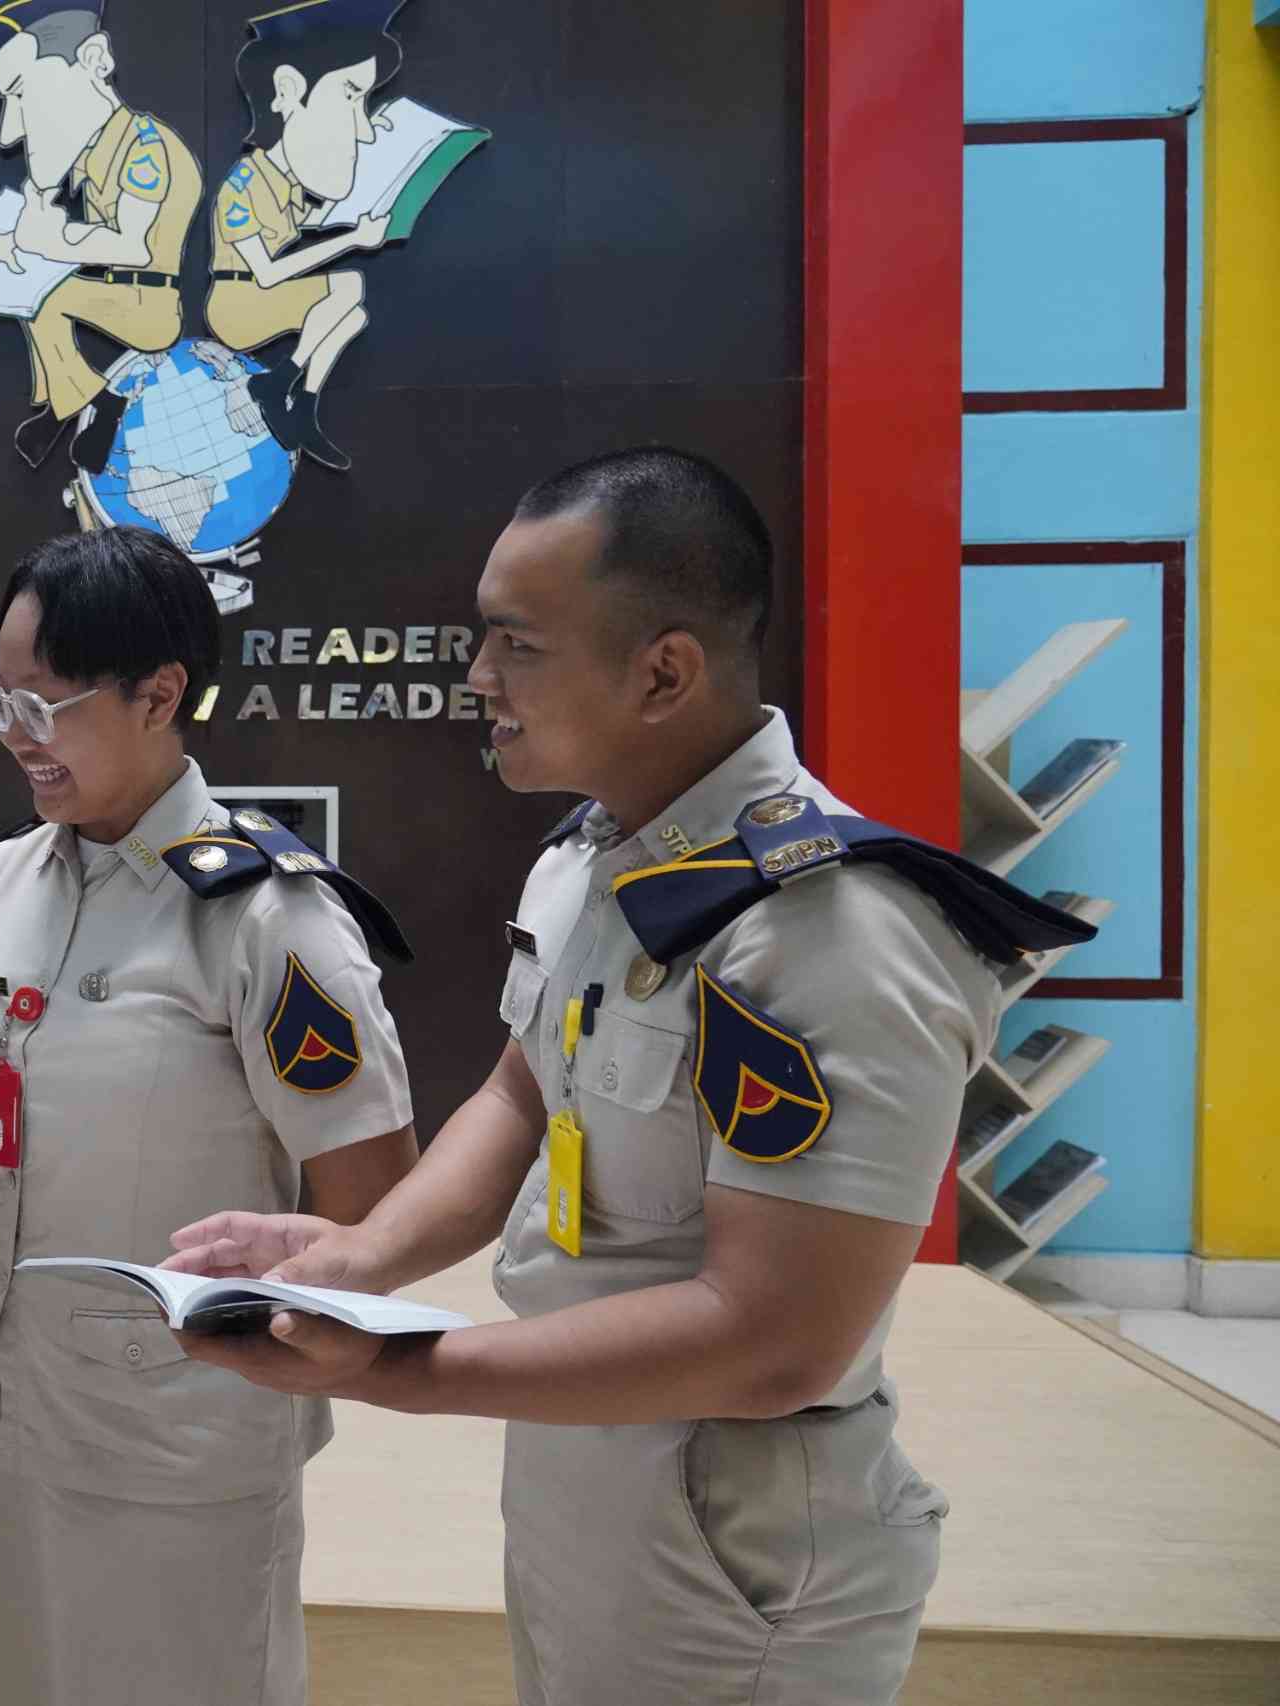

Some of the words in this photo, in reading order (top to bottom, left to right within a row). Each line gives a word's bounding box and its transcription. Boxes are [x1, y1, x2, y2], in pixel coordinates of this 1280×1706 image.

[242, 626, 473, 665] READER
[236, 684, 280, 720] A
[660, 824, 692, 854] STP
[763, 836, 842, 873] STPN
